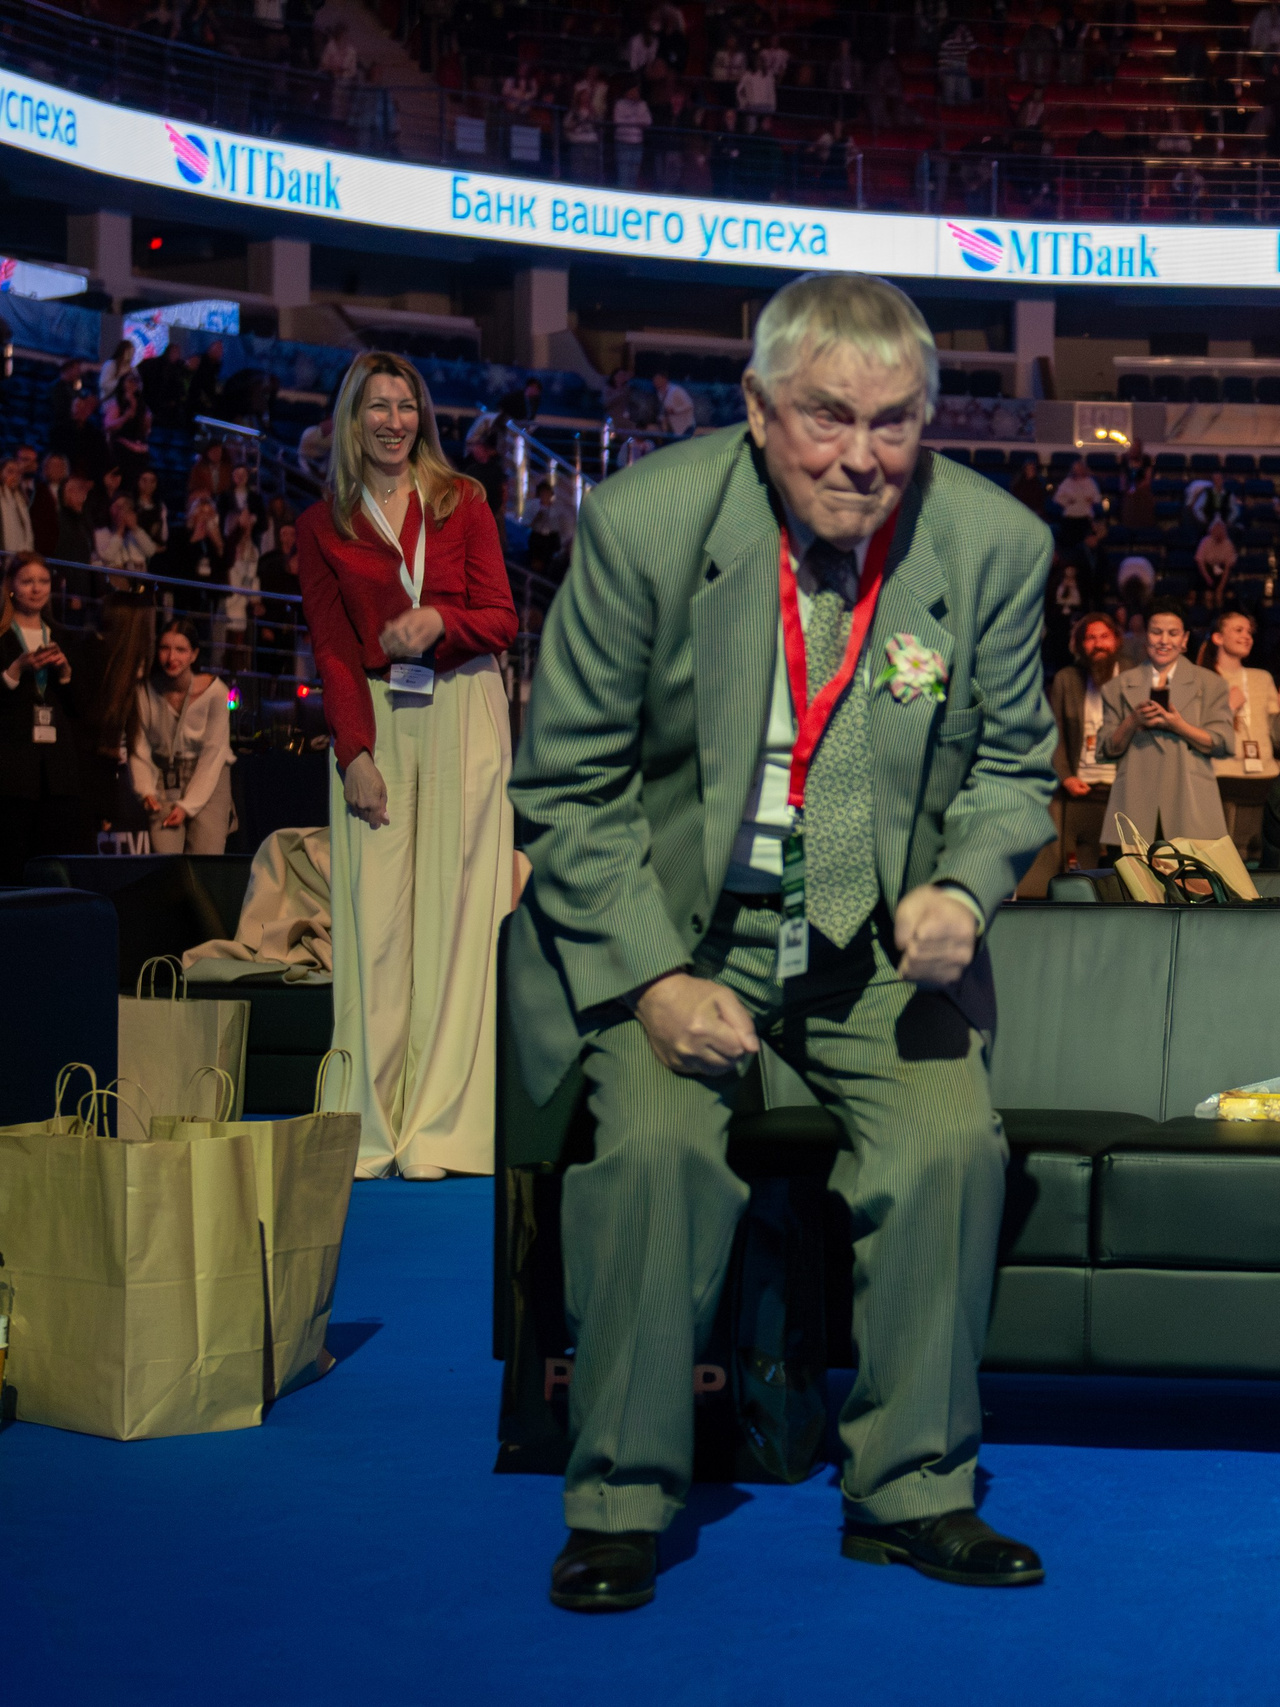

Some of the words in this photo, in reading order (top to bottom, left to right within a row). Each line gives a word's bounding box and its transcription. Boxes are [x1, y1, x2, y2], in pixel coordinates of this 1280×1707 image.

[211, 139, 342, 210] МТБанк
[450, 175, 537, 230] Банк
[551, 200, 685, 245] вашего
[697, 211, 830, 259] успеха
[1006, 229, 1158, 278] МТБанк
